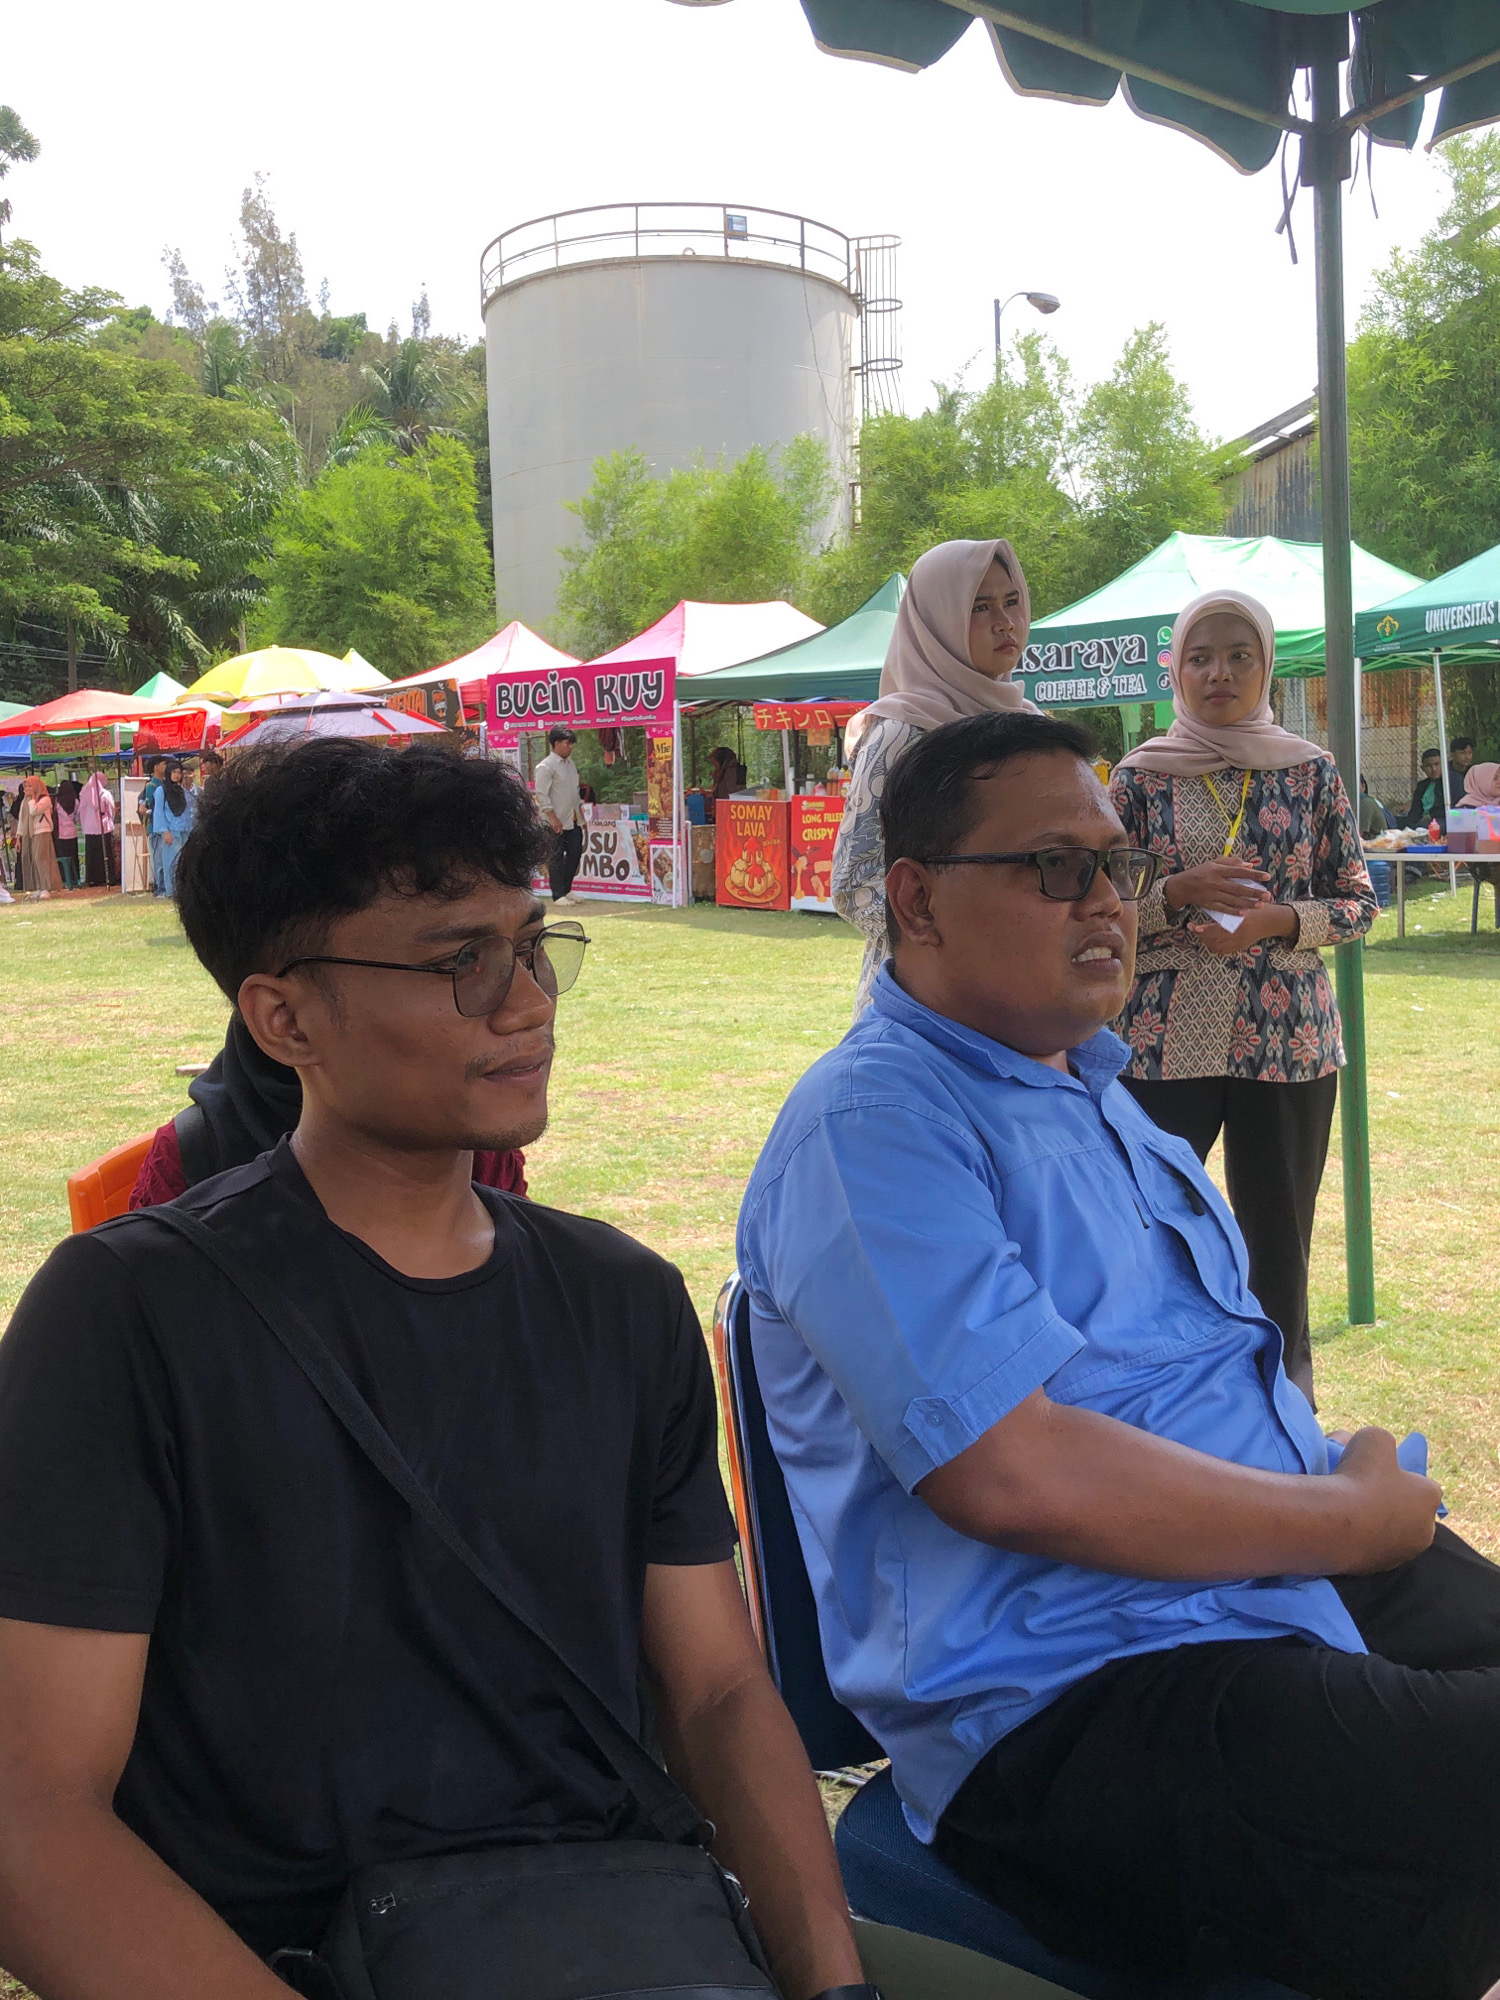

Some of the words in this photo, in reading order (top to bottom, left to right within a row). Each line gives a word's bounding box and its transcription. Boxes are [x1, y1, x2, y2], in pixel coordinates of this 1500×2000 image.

[1425, 600, 1495, 633] UNIVERSITAS
[1035, 678, 1096, 701] COFFEE
[1097, 676, 1110, 698] &
[1112, 673, 1148, 696] TEA
[757, 707, 863, 729] チキンロー
[730, 804, 773, 821] SOMAY
[802, 814, 822, 824] LONG
[737, 822, 766, 838] LAVA
[802, 827, 835, 841] CRISPY
[575, 854, 630, 881] MBO
